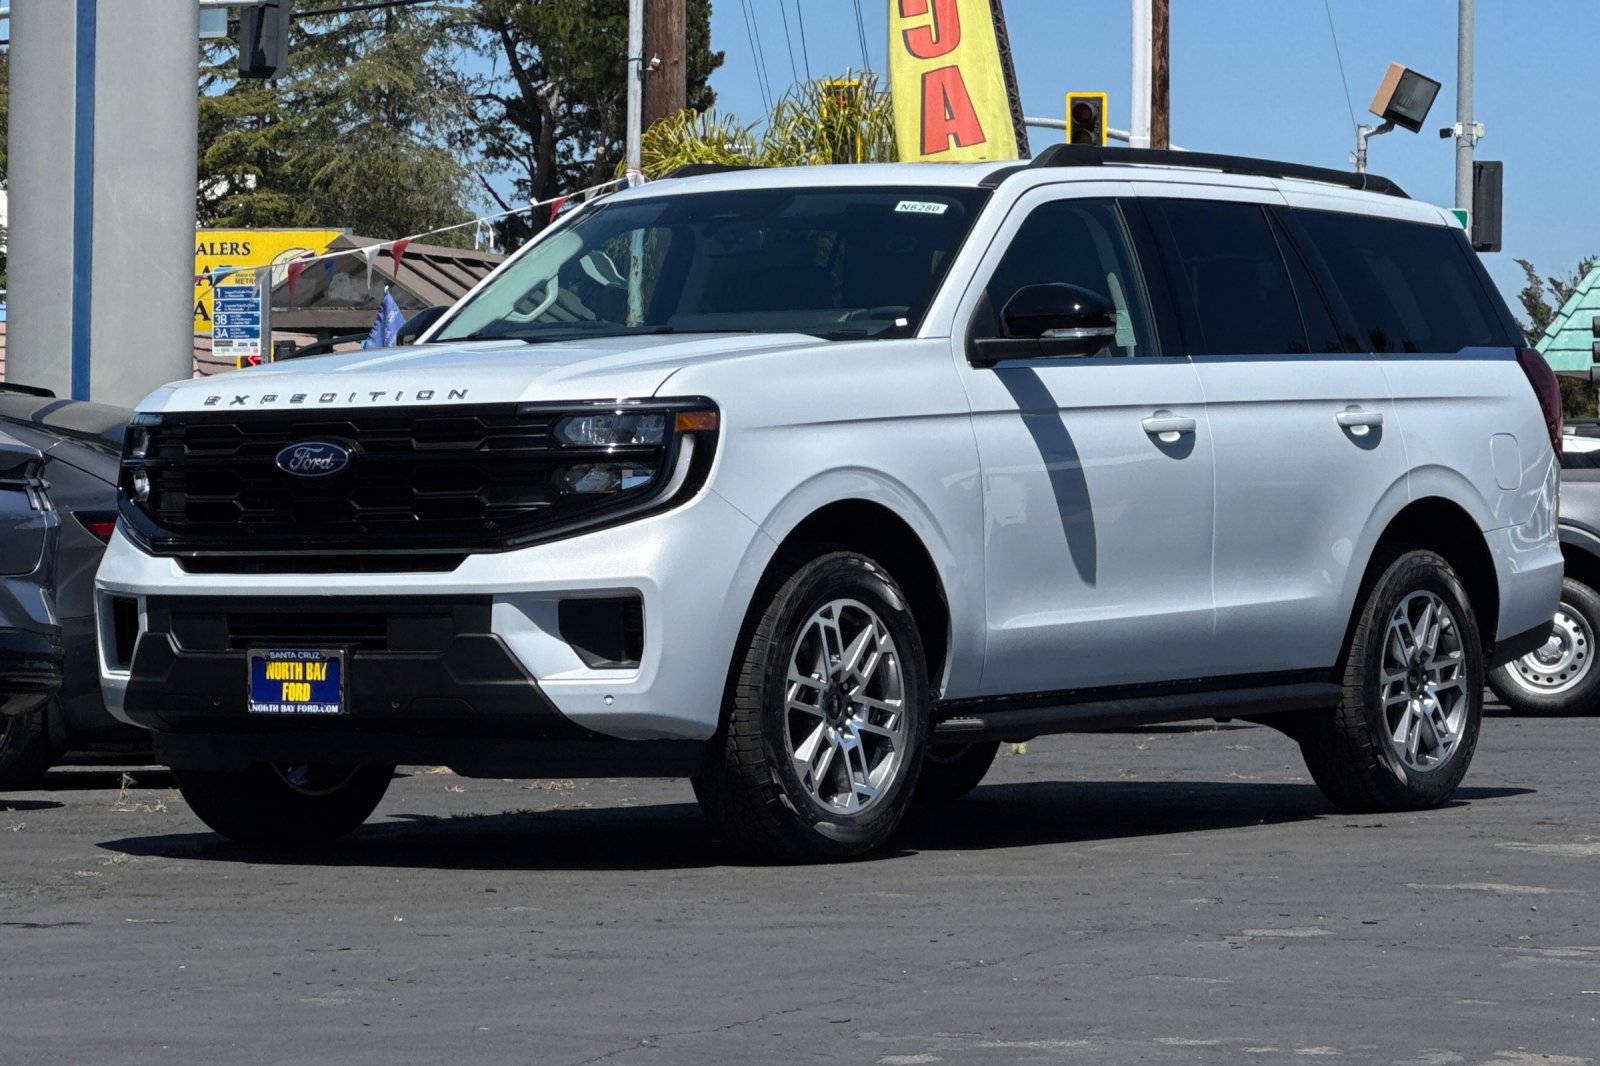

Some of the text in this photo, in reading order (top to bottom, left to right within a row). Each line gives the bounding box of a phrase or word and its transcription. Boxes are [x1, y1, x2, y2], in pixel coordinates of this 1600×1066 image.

[900, 203, 940, 212] N6280
[195, 241, 251, 255] ALERS
[215, 287, 221, 298] 1
[215, 300, 222, 311] 2
[214, 314, 228, 325] 3B
[214, 328, 229, 338] 3A
[204, 388, 469, 407] EXPEDITION
[289, 446, 334, 471] Ford
[269, 651, 321, 659] SANTA CRUZ
[266, 661, 327, 681] NORTH BAY
[282, 682, 311, 702] FORD
[251, 703, 279, 713] NORTH
[281, 704, 295, 713] BAY
